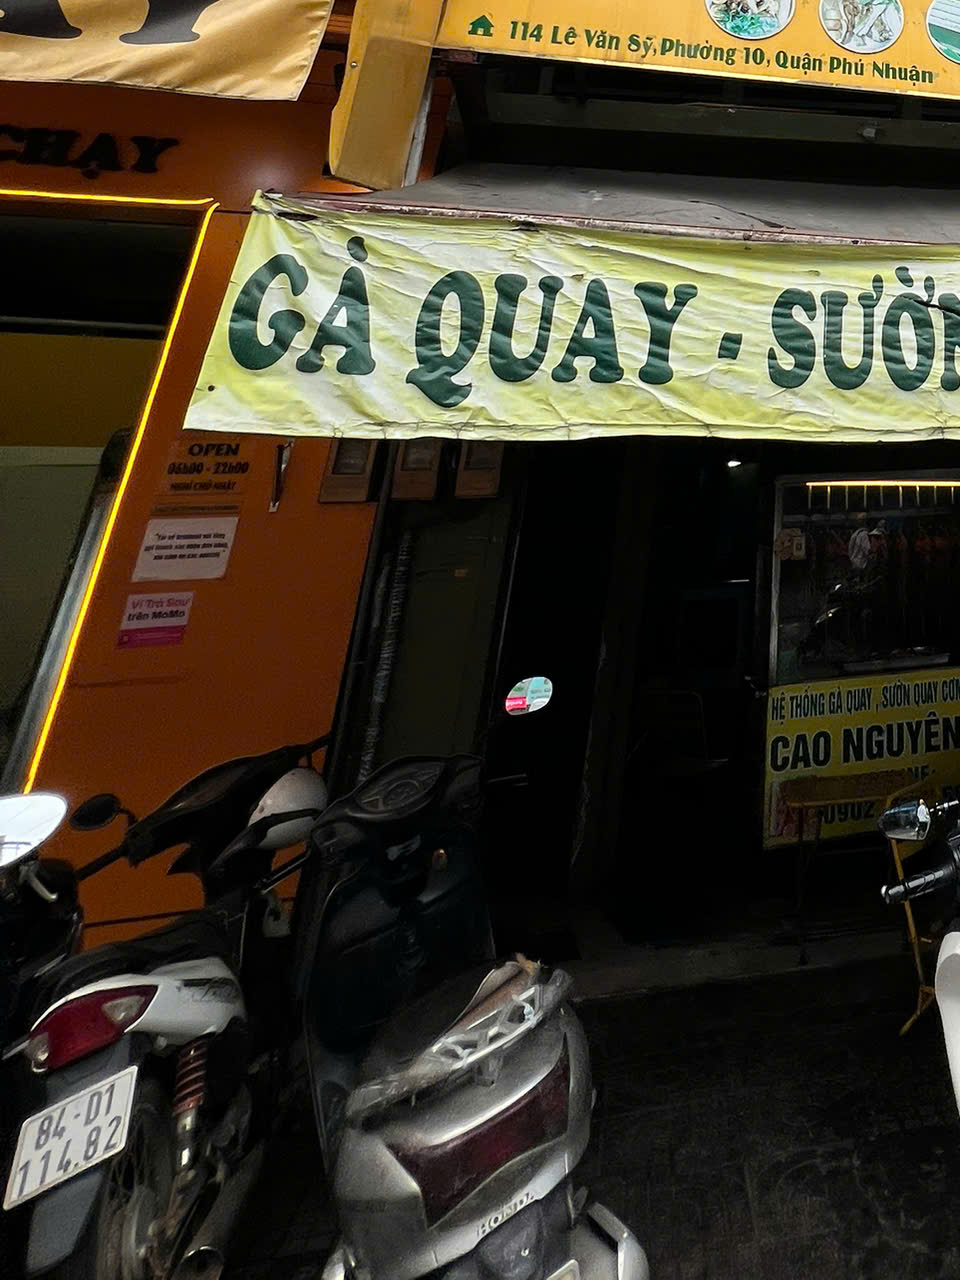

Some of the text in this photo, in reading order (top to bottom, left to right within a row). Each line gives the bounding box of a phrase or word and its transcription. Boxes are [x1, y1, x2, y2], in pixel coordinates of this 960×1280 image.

[508, 20, 543, 43] 114
[551, 24, 577, 47] Lê
[585, 29, 620, 51] Văn
[659, 38, 738, 68] Phường
[774, 50, 823, 75] Quận
[828, 54, 865, 77] Phú
[871, 61, 935, 85] Nhuận
[405, 268, 698, 410] QUAY
[187, 442, 241, 457] OPEN
[213, 461, 250, 475] 22h00
[846, 686, 873, 713] QUAY
[913, 681, 940, 708] QUAY
[769, 729, 832, 773] CAO
[17, 1115, 123, 1198] 114.82
